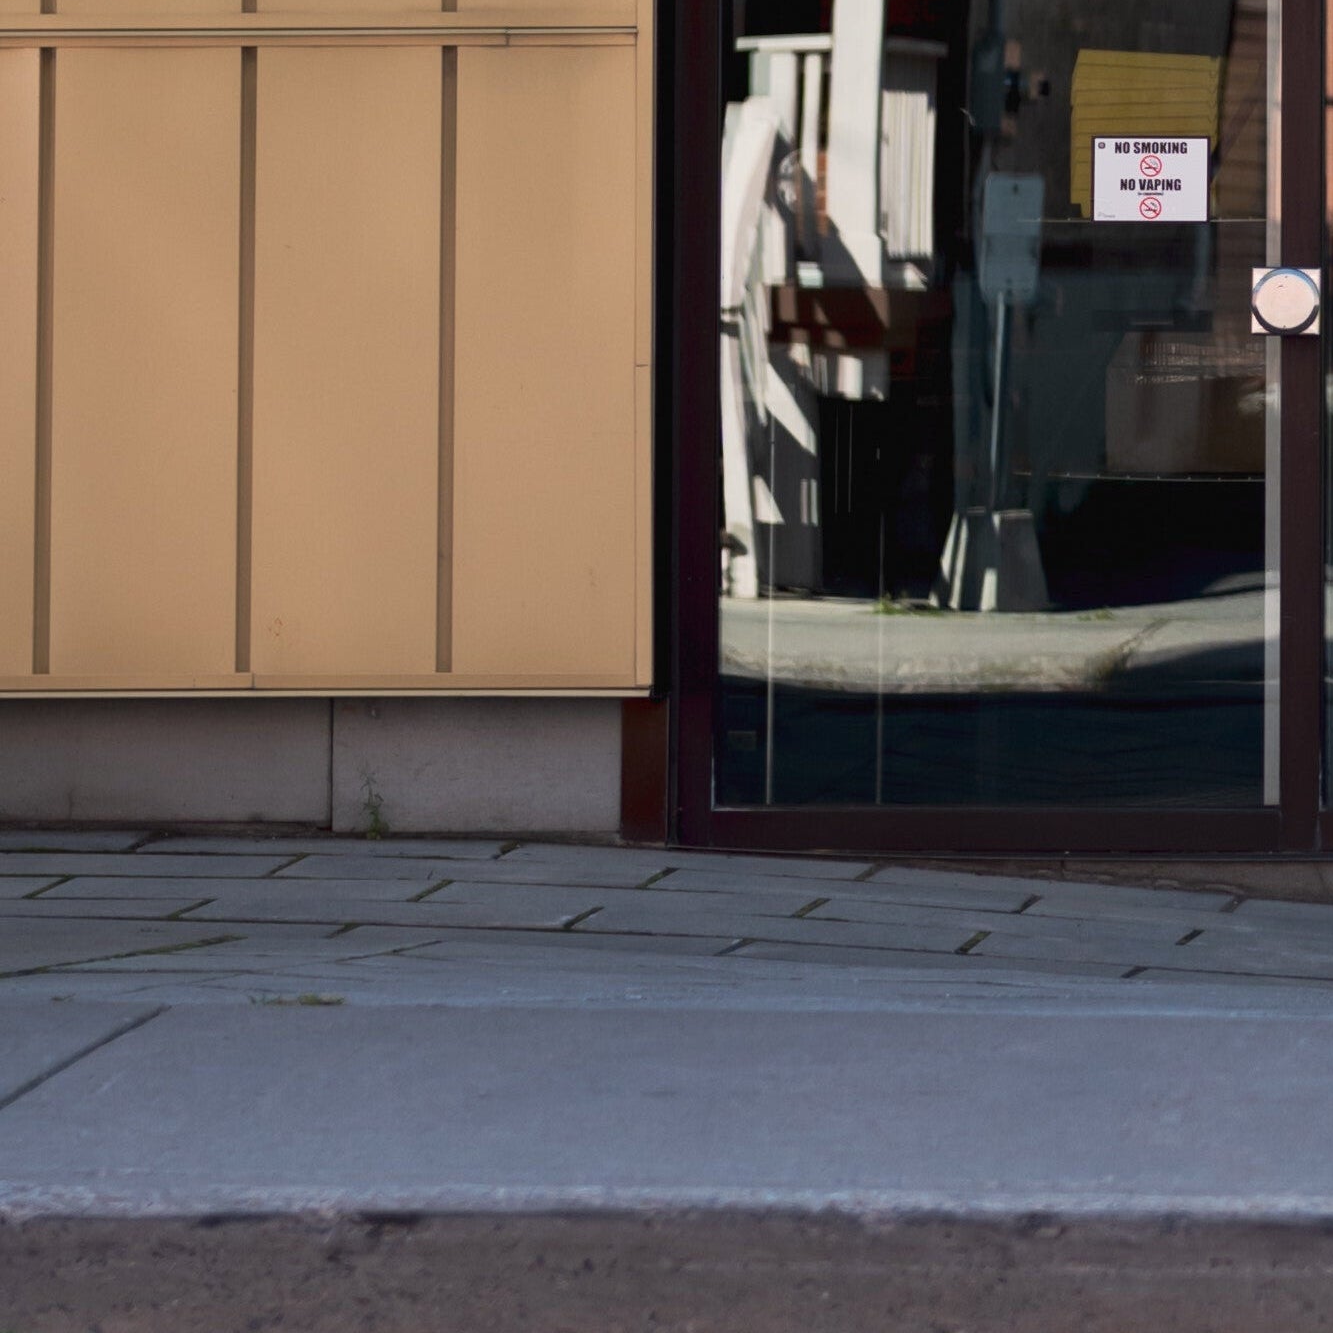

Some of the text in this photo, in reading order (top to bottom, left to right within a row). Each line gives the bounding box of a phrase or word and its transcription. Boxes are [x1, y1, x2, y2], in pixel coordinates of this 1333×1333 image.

[1114, 141, 1188, 154] NO SMOKING
[1120, 178, 1182, 191] NO VAPING
